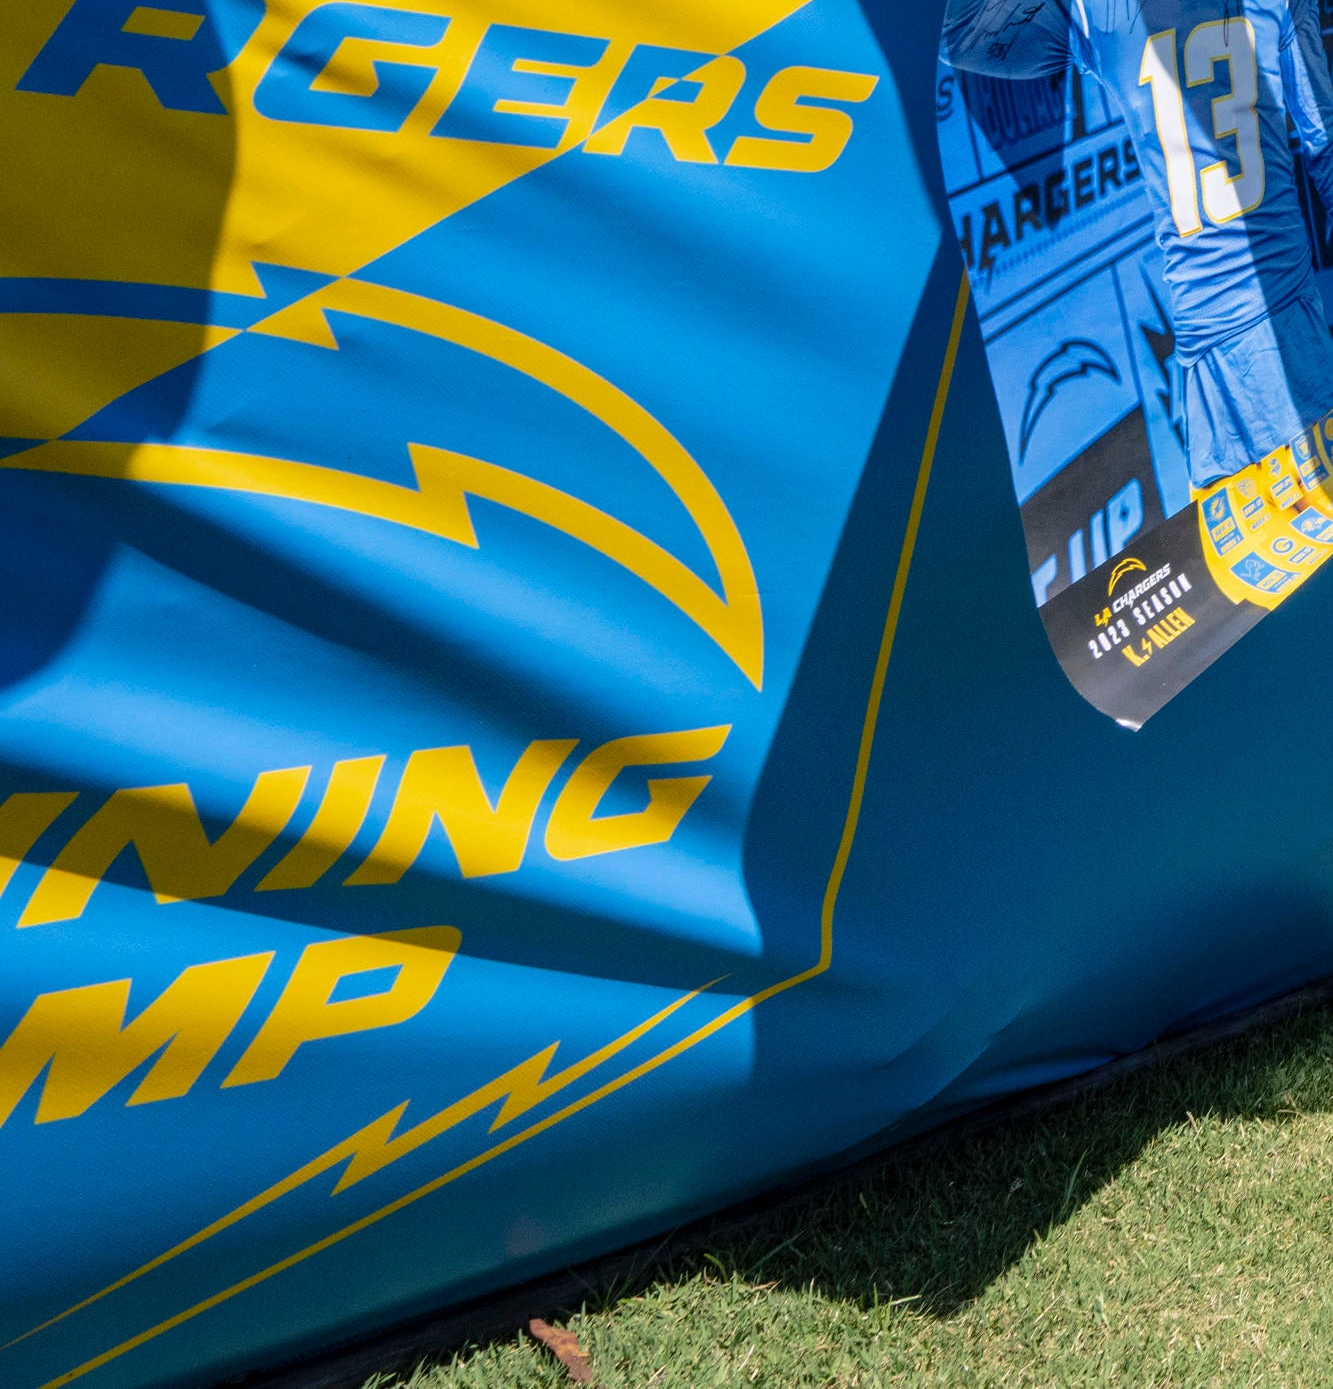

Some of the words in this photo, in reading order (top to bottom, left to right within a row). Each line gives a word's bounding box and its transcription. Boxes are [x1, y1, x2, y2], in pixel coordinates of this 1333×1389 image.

[1138, 15, 1266, 238] 13
[1088, 618, 1131, 660] 2023
[1132, 572, 1193, 626] SEASON
[1094, 606, 1113, 628] LA
[1112, 562, 1172, 614] CHARGERS
[1146, 606, 1196, 650] ALLEN
